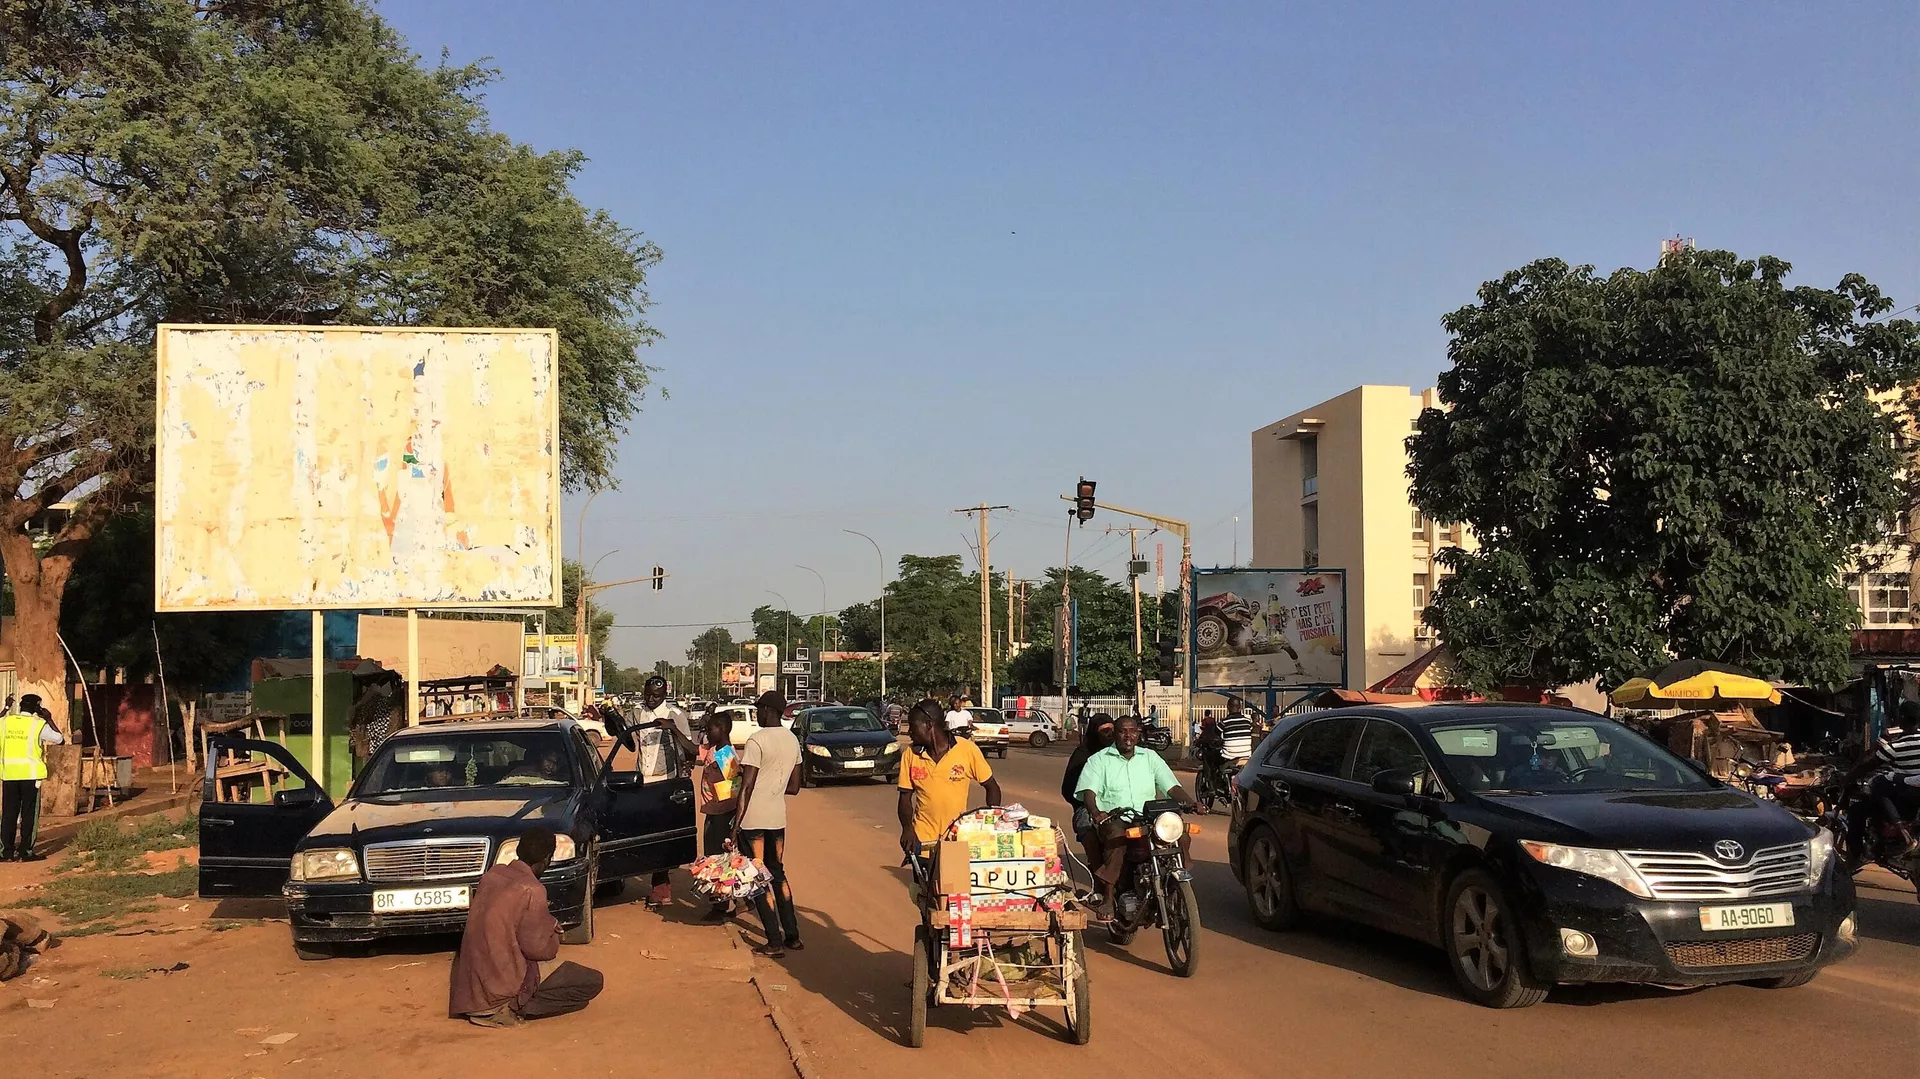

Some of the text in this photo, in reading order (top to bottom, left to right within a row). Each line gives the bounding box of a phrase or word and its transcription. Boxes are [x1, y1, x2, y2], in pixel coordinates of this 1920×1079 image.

[1290, 600, 1331, 619] C'EST PETIT
[1296, 612, 1335, 630] MAIS C'EST
[414, 890, 452, 906] 6585
